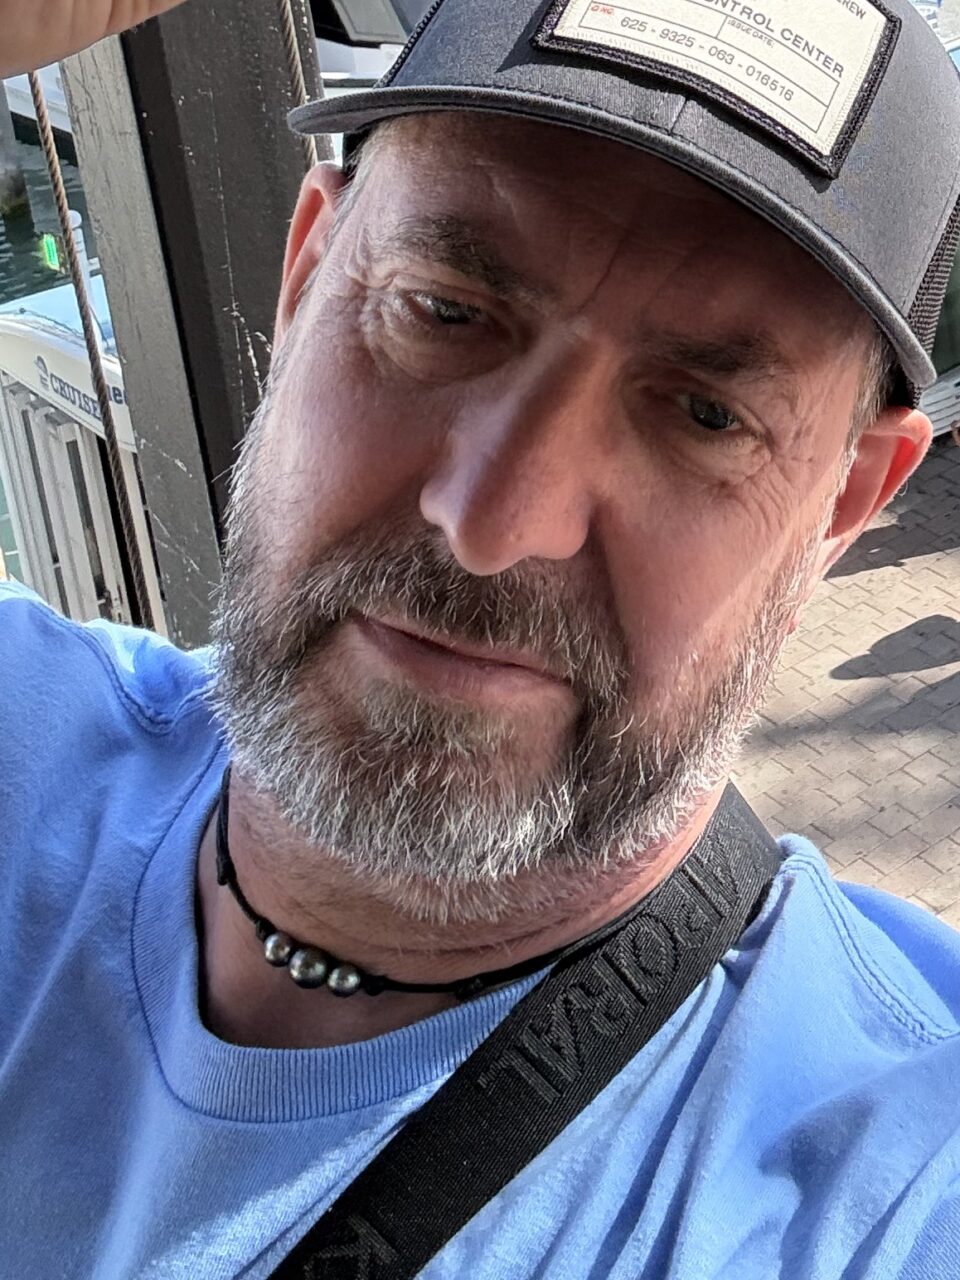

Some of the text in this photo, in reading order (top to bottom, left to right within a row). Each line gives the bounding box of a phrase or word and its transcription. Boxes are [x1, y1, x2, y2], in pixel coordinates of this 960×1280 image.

[621, 17, 648, 32] 625
[660, 28, 696, 48] 9325
[708, 45, 735, 65] 063
[745, 65, 794, 102] 016516
[780, 28, 844, 78] CENTER
[477, 830, 742, 1104] APORAL
